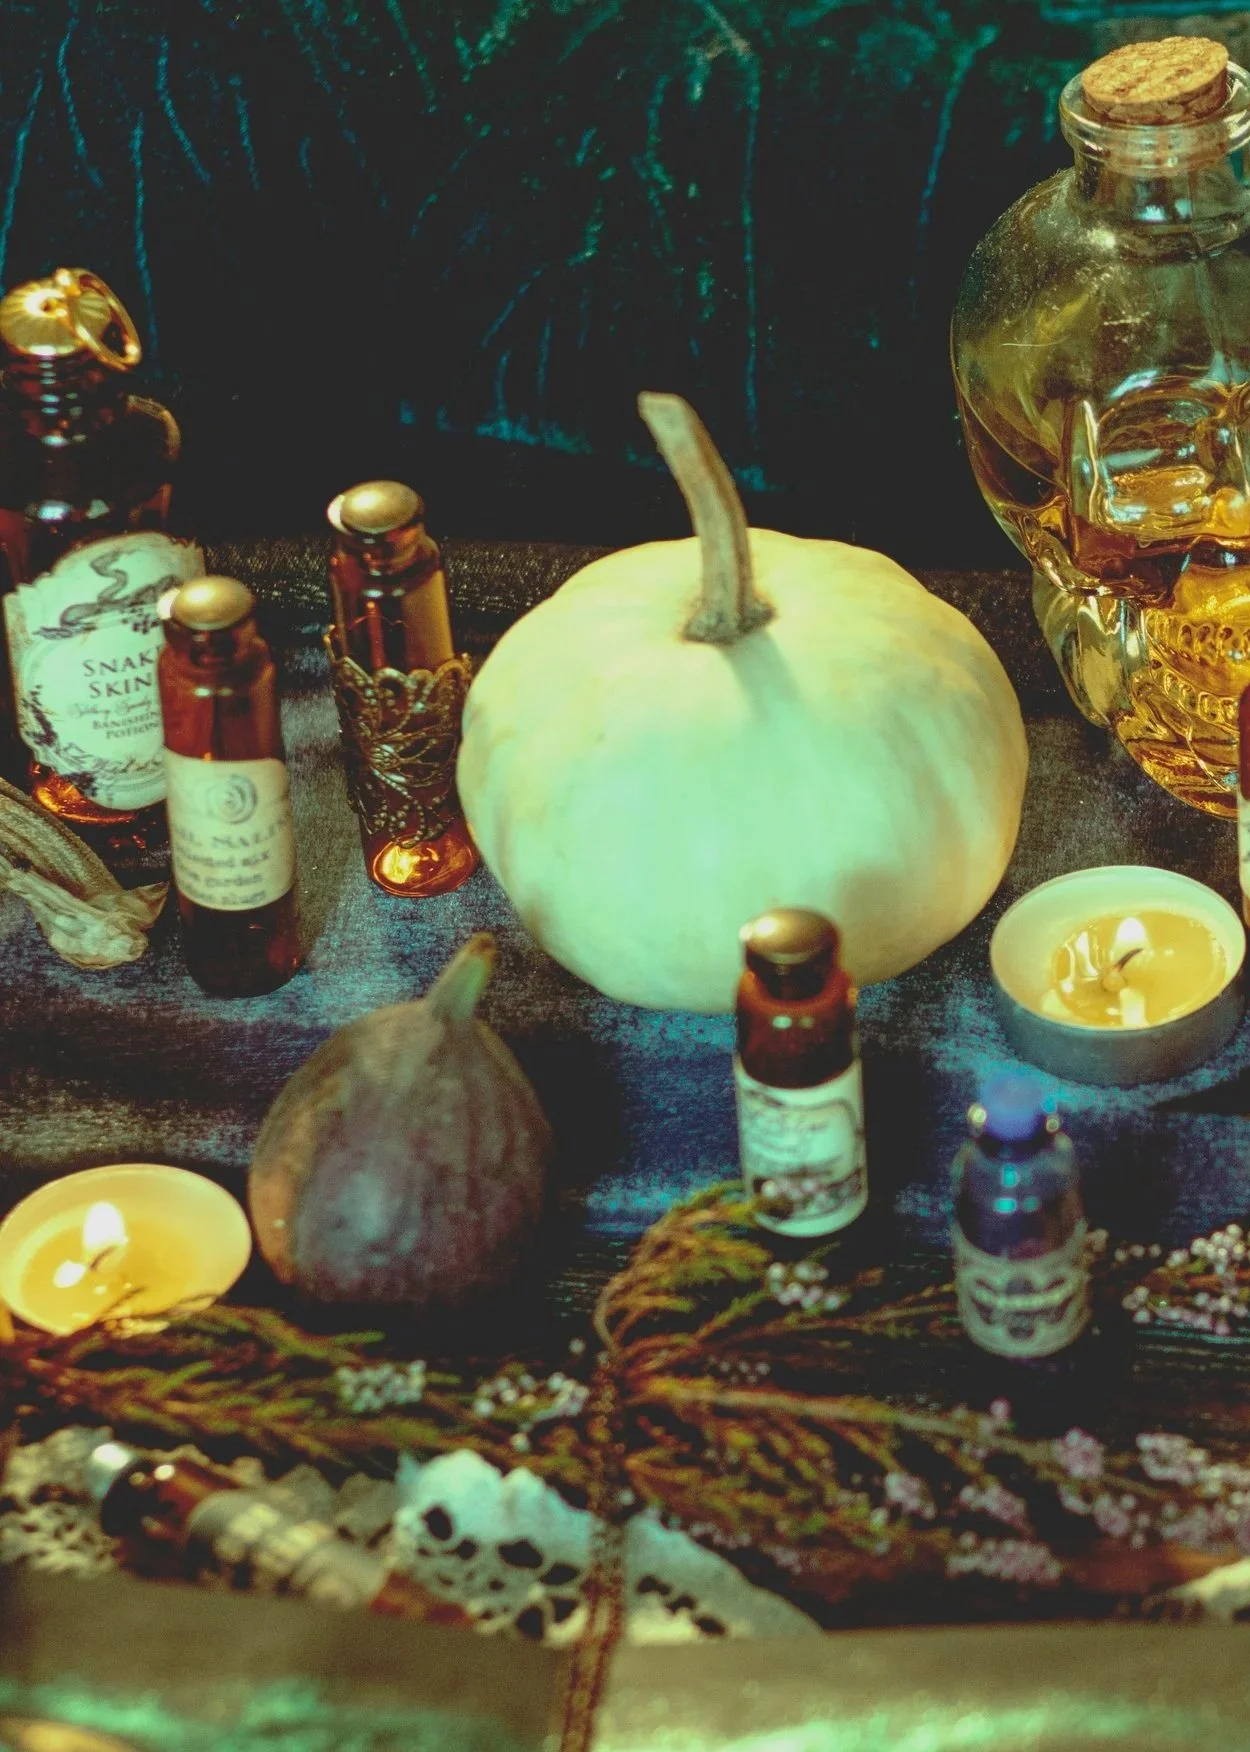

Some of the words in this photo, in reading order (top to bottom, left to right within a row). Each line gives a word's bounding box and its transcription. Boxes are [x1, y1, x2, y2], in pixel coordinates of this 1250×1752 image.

[88, 672, 152, 699] SKIN
[92, 710, 160, 730] BANISHIN
[106, 721, 160, 739] POTION
